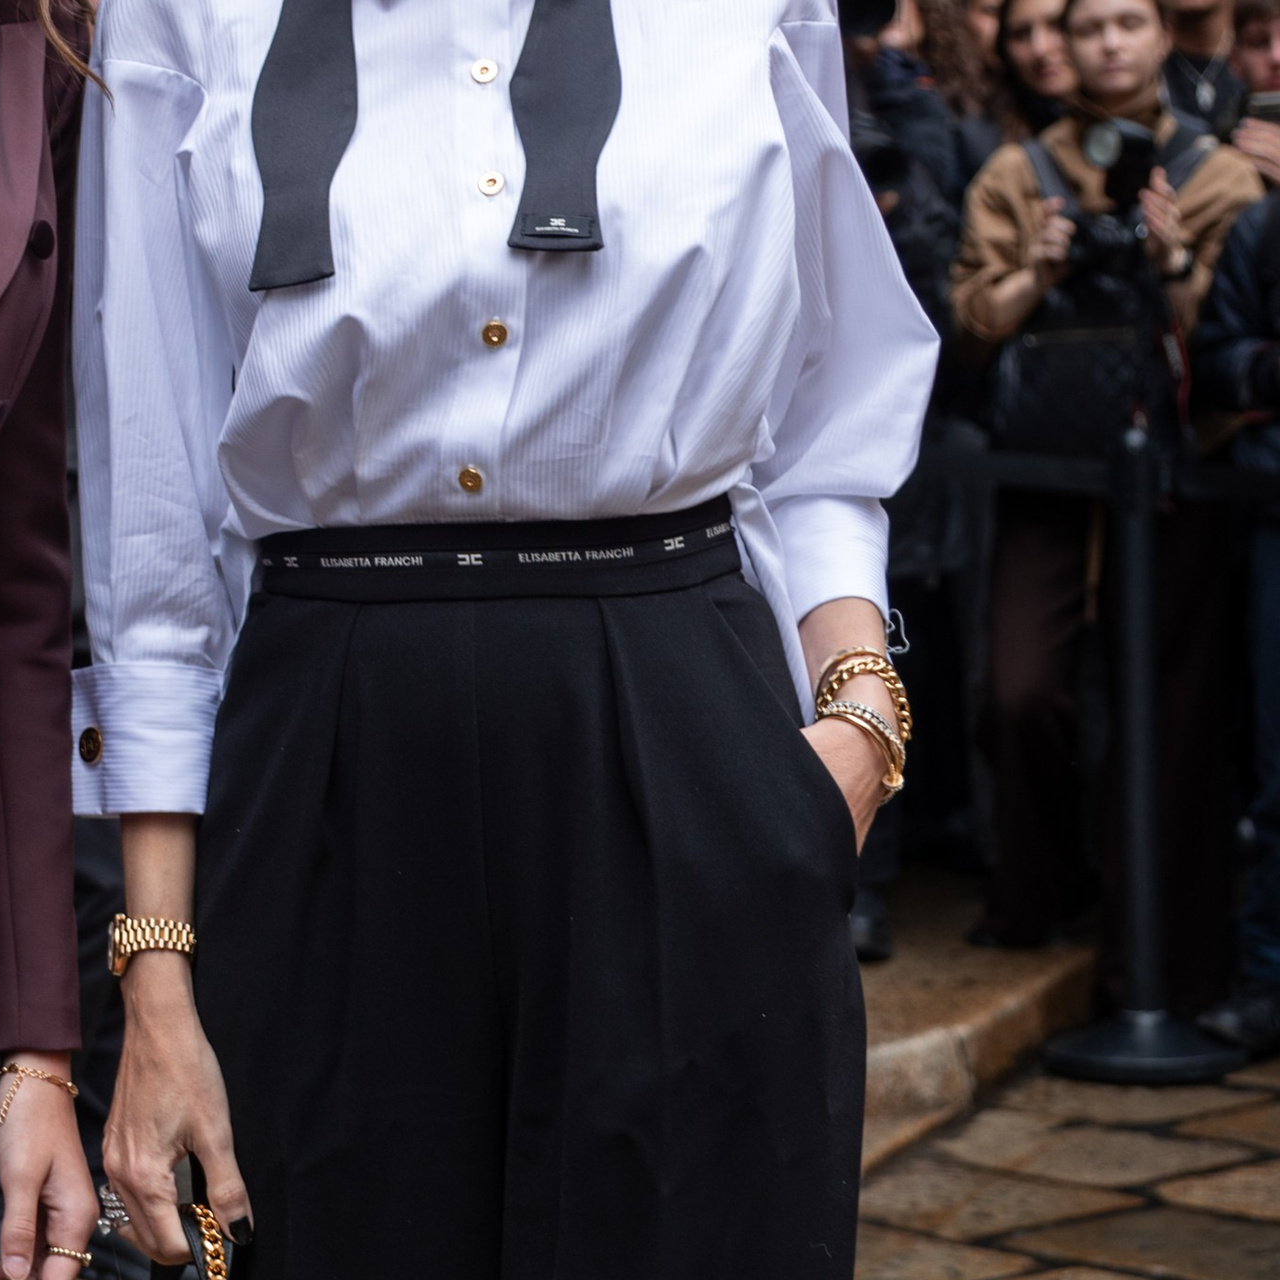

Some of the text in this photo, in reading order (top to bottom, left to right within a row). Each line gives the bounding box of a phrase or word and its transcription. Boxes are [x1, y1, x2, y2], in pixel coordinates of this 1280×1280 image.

[320, 557, 371, 568] ELISABETTA
[374, 556, 424, 567] FRANCHI
[518, 551, 582, 563] ELISABETTA
[585, 546, 634, 560] FRANCHI
